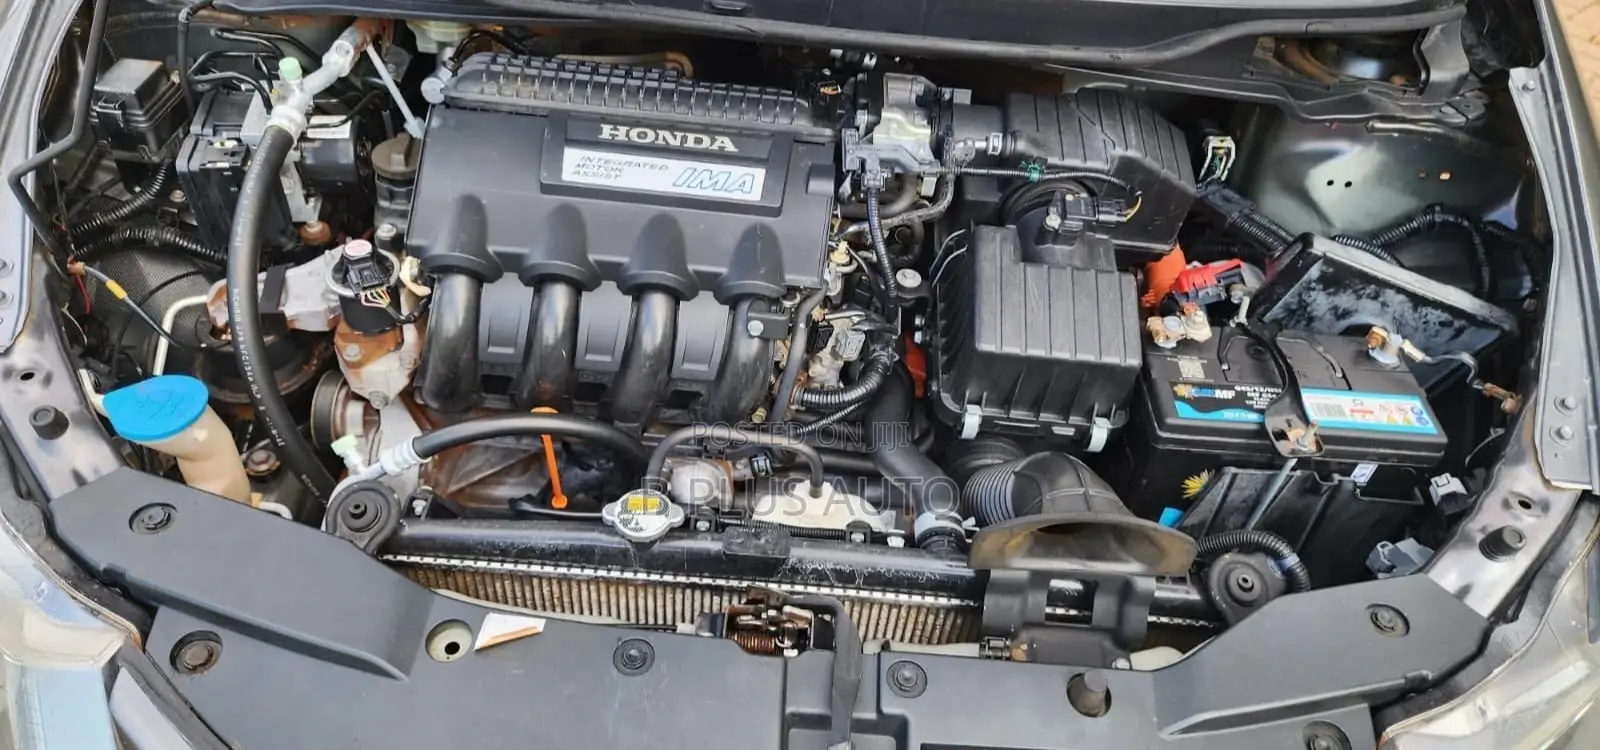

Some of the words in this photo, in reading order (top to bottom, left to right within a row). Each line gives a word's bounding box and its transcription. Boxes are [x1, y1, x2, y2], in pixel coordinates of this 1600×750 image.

[598, 123, 739, 152] HONDA
[575, 163, 624, 173] MOTOR
[579, 156, 669, 171] INTEGRATED
[572, 170, 622, 180] ASSIST
[672, 167, 755, 194] IMA
